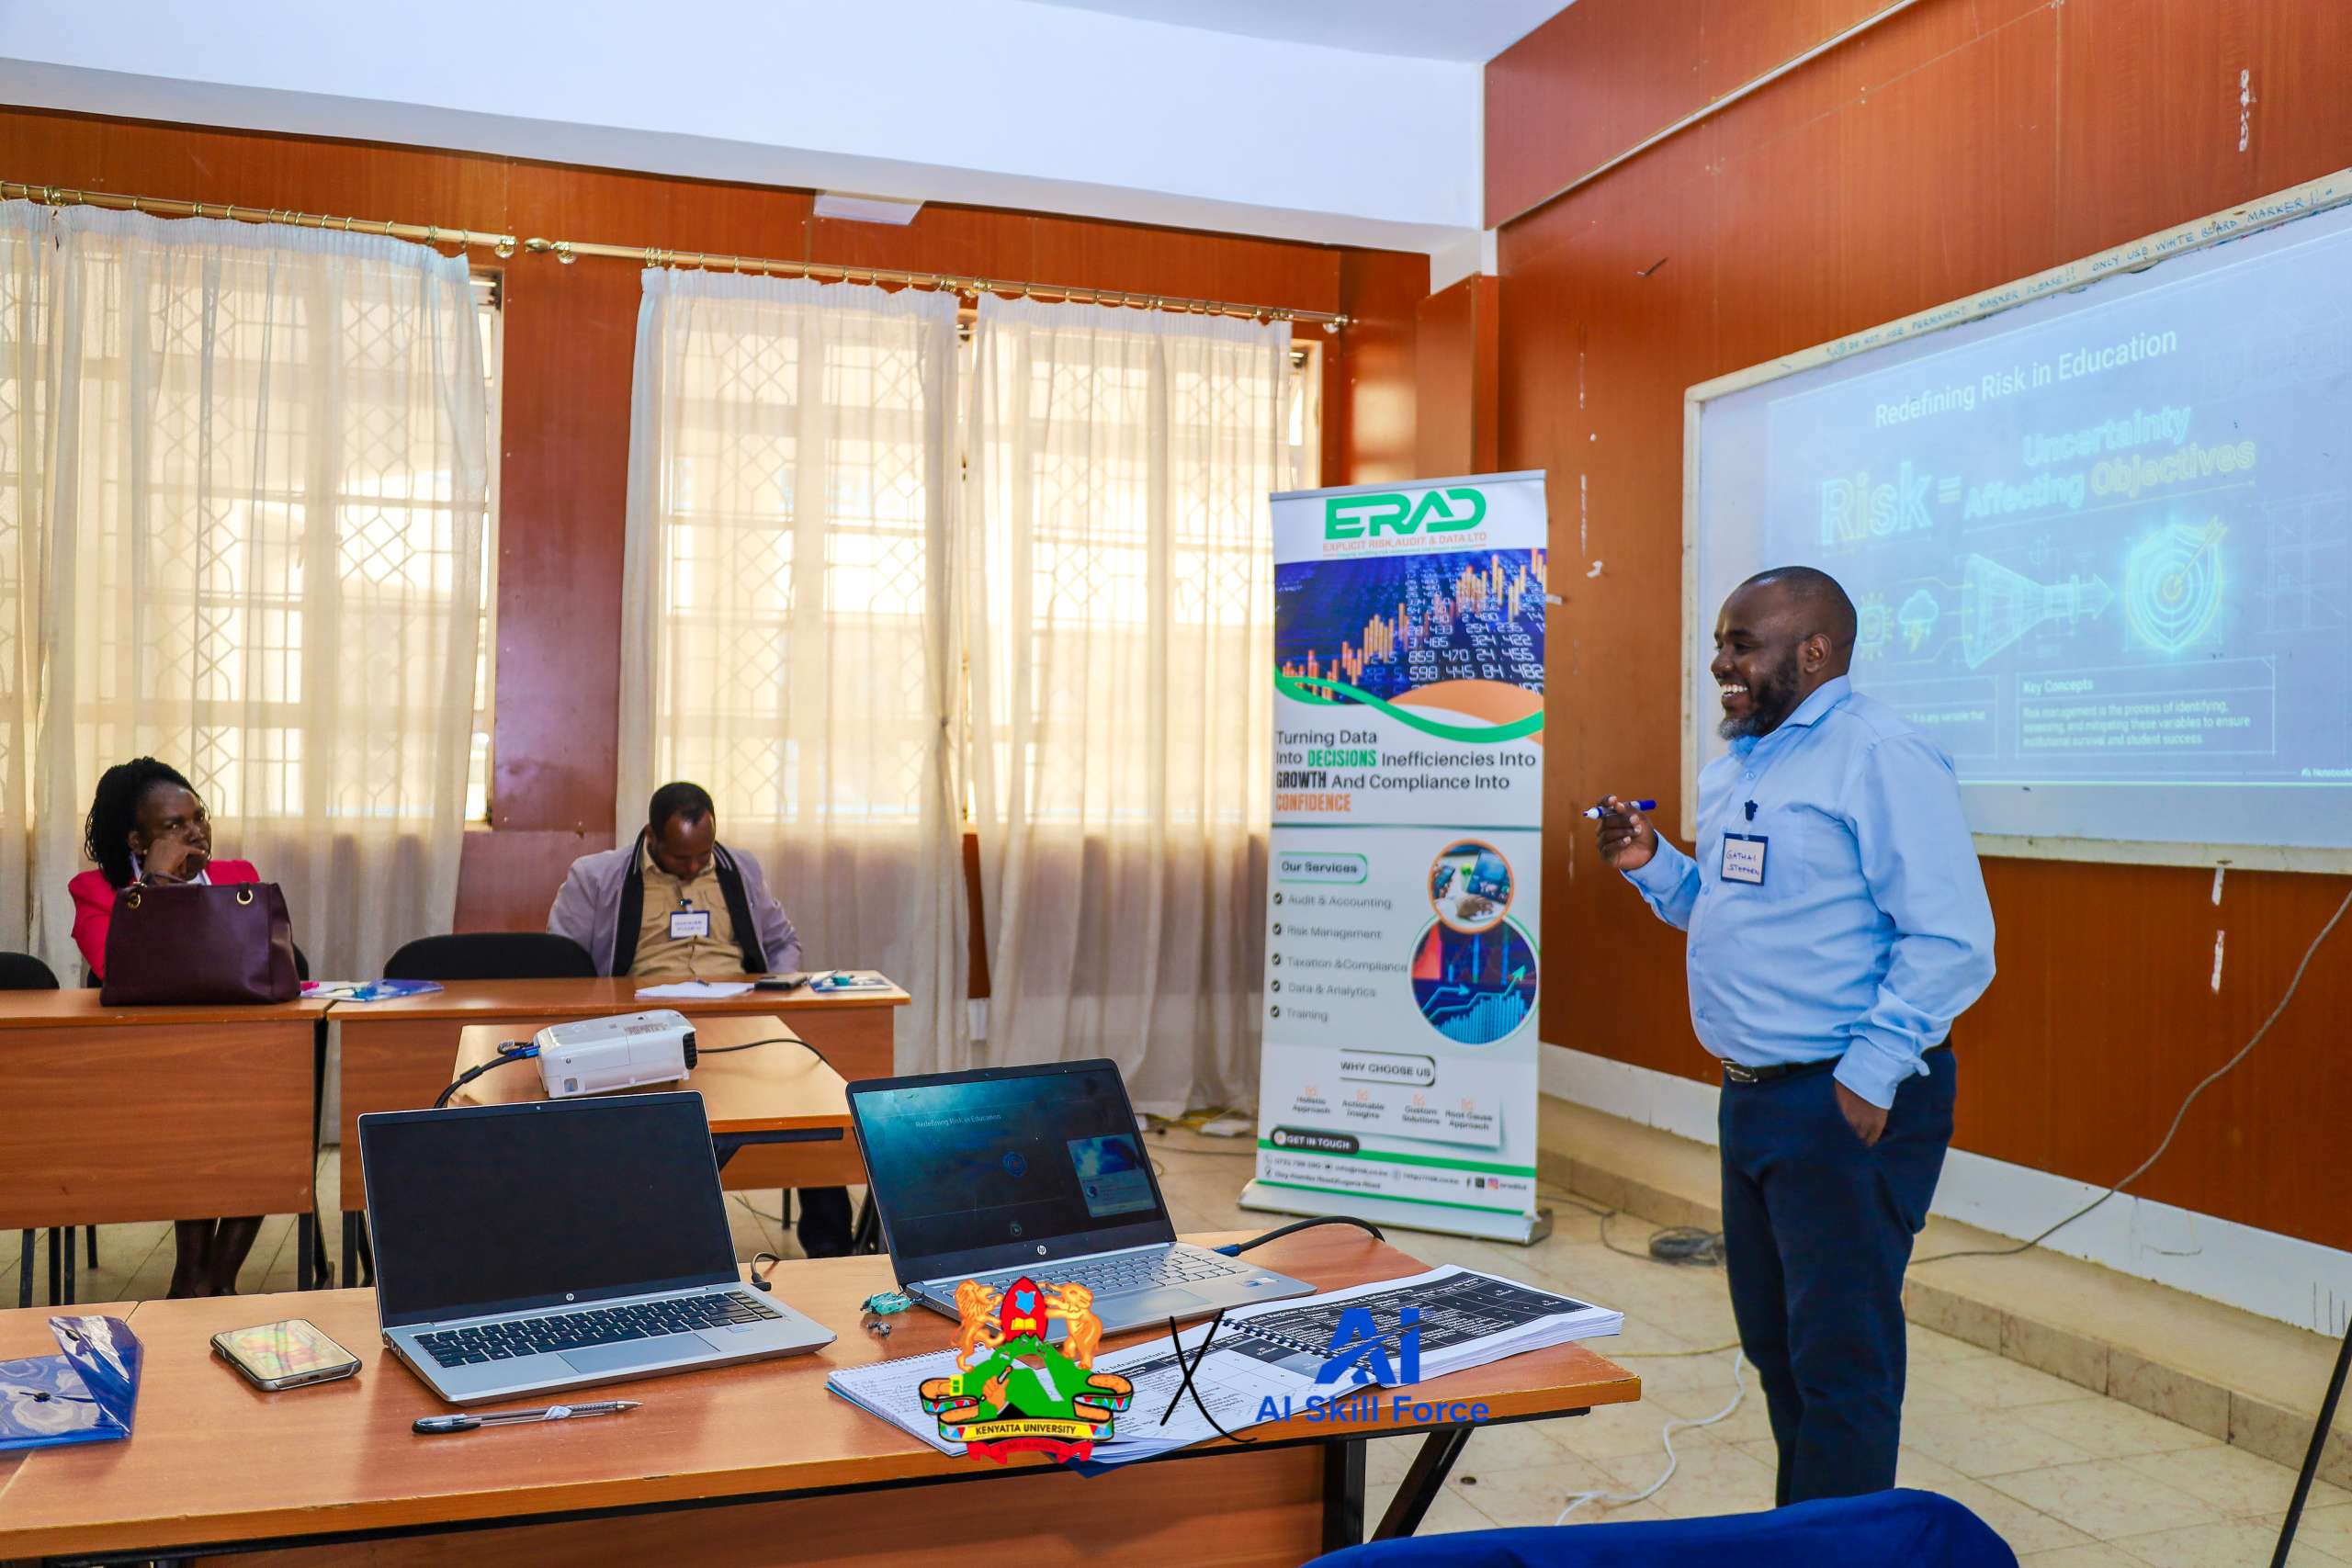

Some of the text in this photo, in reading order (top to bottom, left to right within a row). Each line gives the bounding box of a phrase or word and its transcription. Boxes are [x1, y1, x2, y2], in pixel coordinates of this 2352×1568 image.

[1911, 306, 1966, 331] PERMANENT
[1978, 290, 2019, 310] MARKER
[2092, 256, 2119, 272] ONLY
[2128, 245, 2148, 261] USE
[2155, 231, 2194, 252] WHITE
[2247, 197, 2304, 222] MARKER
[1875, 330, 2177, 428] Redefining Risk in Education
[2022, 406, 2191, 466] Uncertainty
[1820, 461, 1933, 546] Risk
[1962, 472, 2086, 521] Affecting
[2091, 440, 2256, 498] Objectives
[1324, 488, 1487, 540] ERAD
[1323, 540, 1366, 552] EXPLICIT
[1439, 533, 1466, 545] DATA
[1468, 532, 1487, 542] LTD
[2023, 678, 2094, 695] Key Concepts
[2124, 705, 2161, 716] process
[2163, 701, 2174, 715] of
[2203, 716, 2214, 728] to
[2216, 716, 2251, 728] ensure
[1276, 730, 1378, 747] Turning Data
[1276, 750, 1536, 767] Into DECISIONS Inefficiencies Into
[1275, 771, 1510, 792] GROWTH And Compliance Into
[1275, 794, 1351, 812] CONFIDENCE
[1281, 861, 1358, 874] Our Services
[1288, 895, 1314, 906] Audit
[1329, 896, 1393, 909] Accounting
[1286, 926, 1383, 941] Risk Management
[1287, 957, 1332, 968] Taxation
[1288, 983, 1313, 994] Data
[1326, 984, 1377, 998] Analytics
[1286, 1009, 1329, 1023] Training
[1340, 1061, 1431, 1077] WHY CHOOSE US
[1286, 1135, 1351, 1150] GET IN TOUCH
